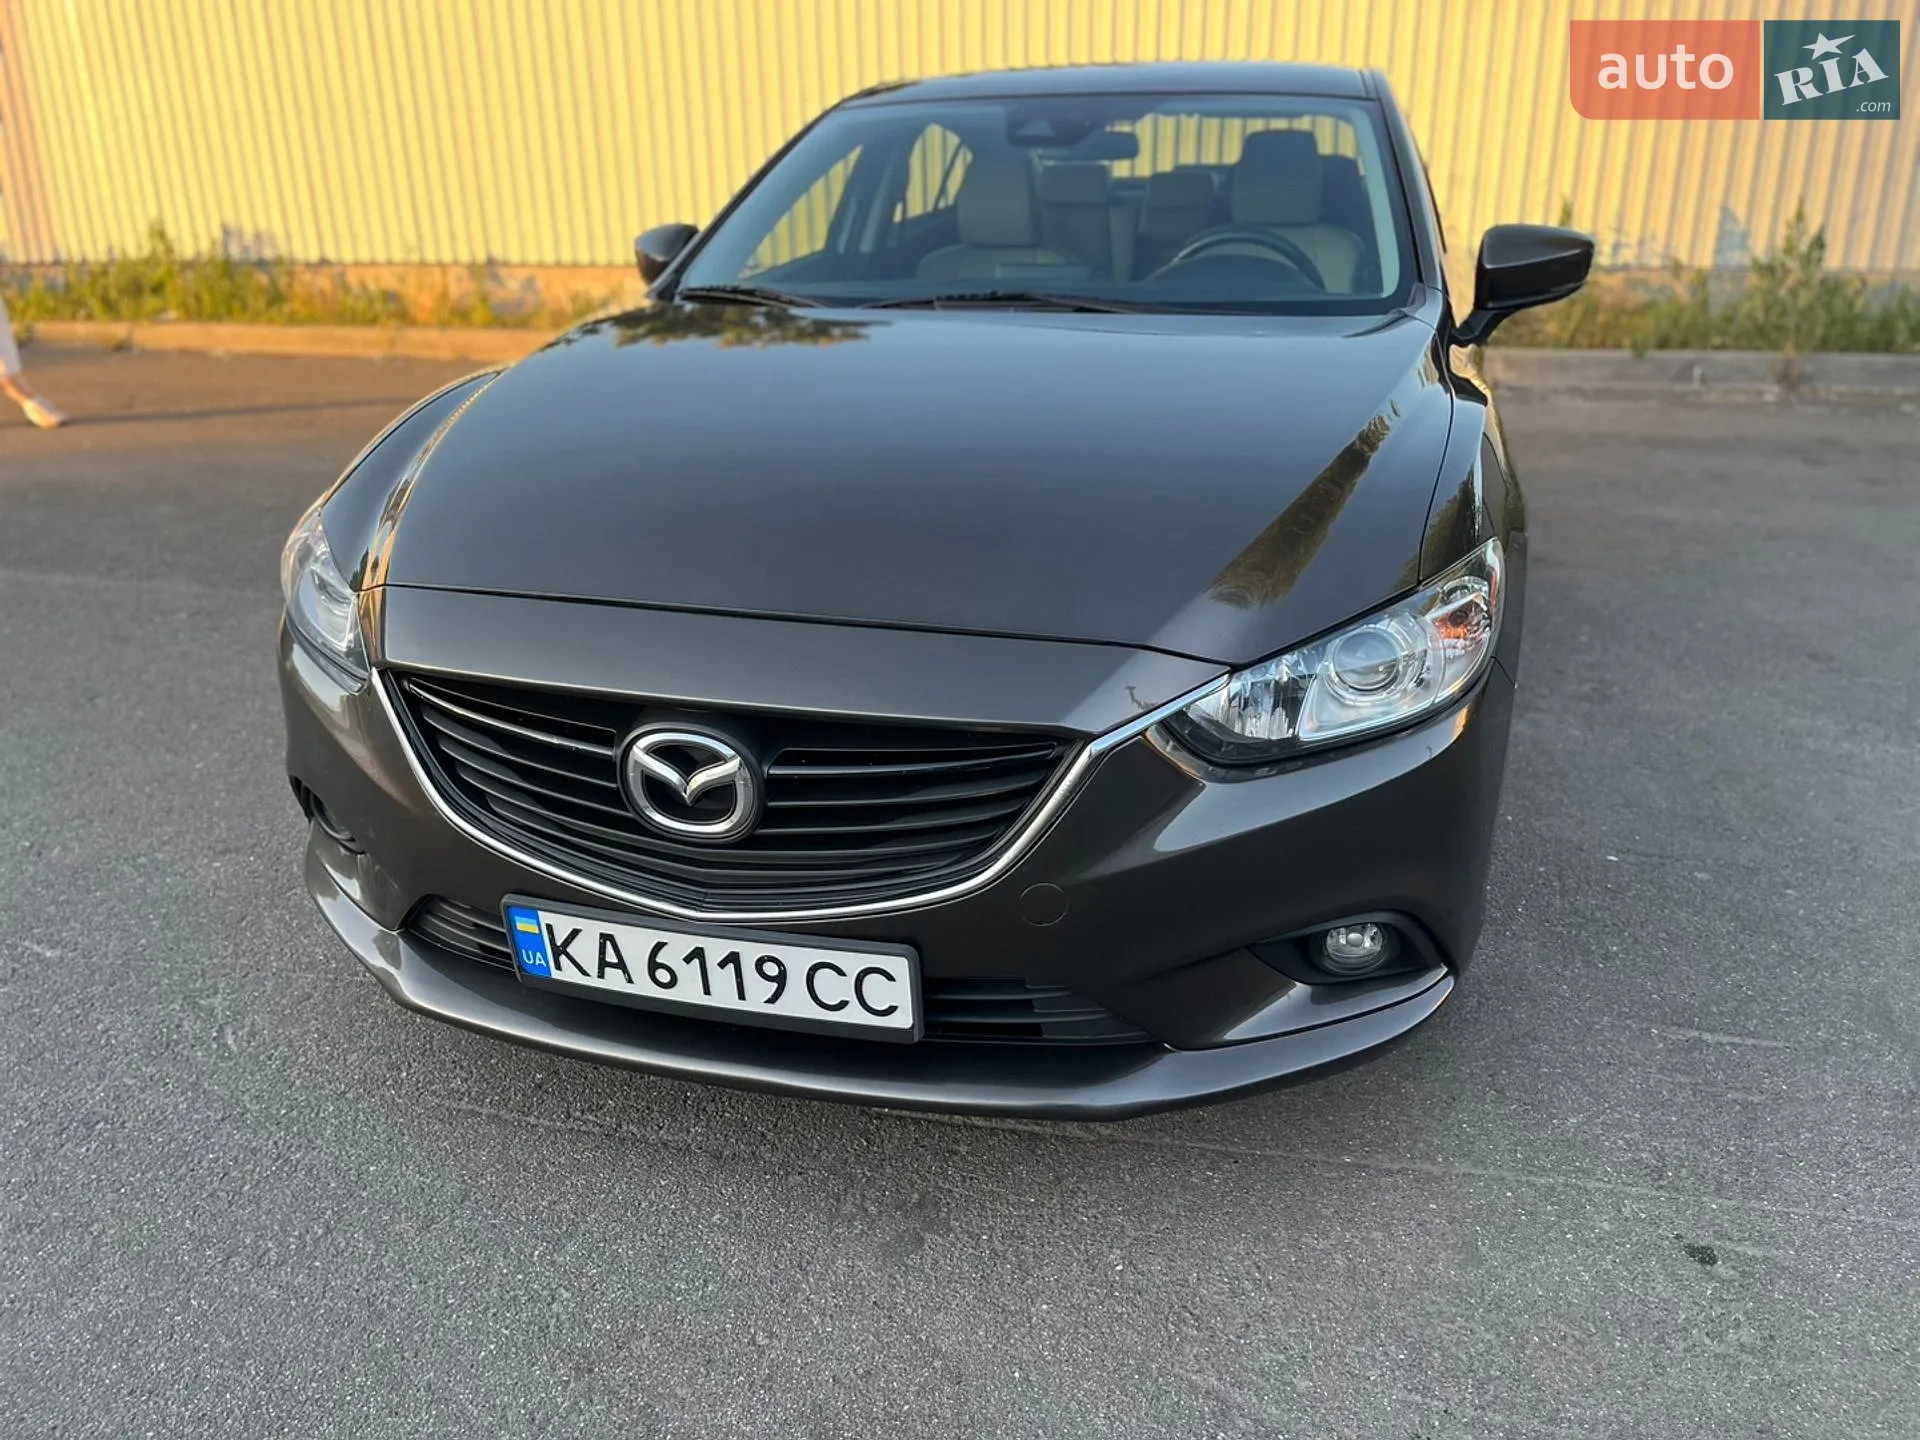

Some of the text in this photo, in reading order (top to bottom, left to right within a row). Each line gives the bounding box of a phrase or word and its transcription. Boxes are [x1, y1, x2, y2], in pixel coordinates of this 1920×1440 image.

[522, 949, 547, 968] UA
[545, 922, 899, 1018] KA 6119 CC
